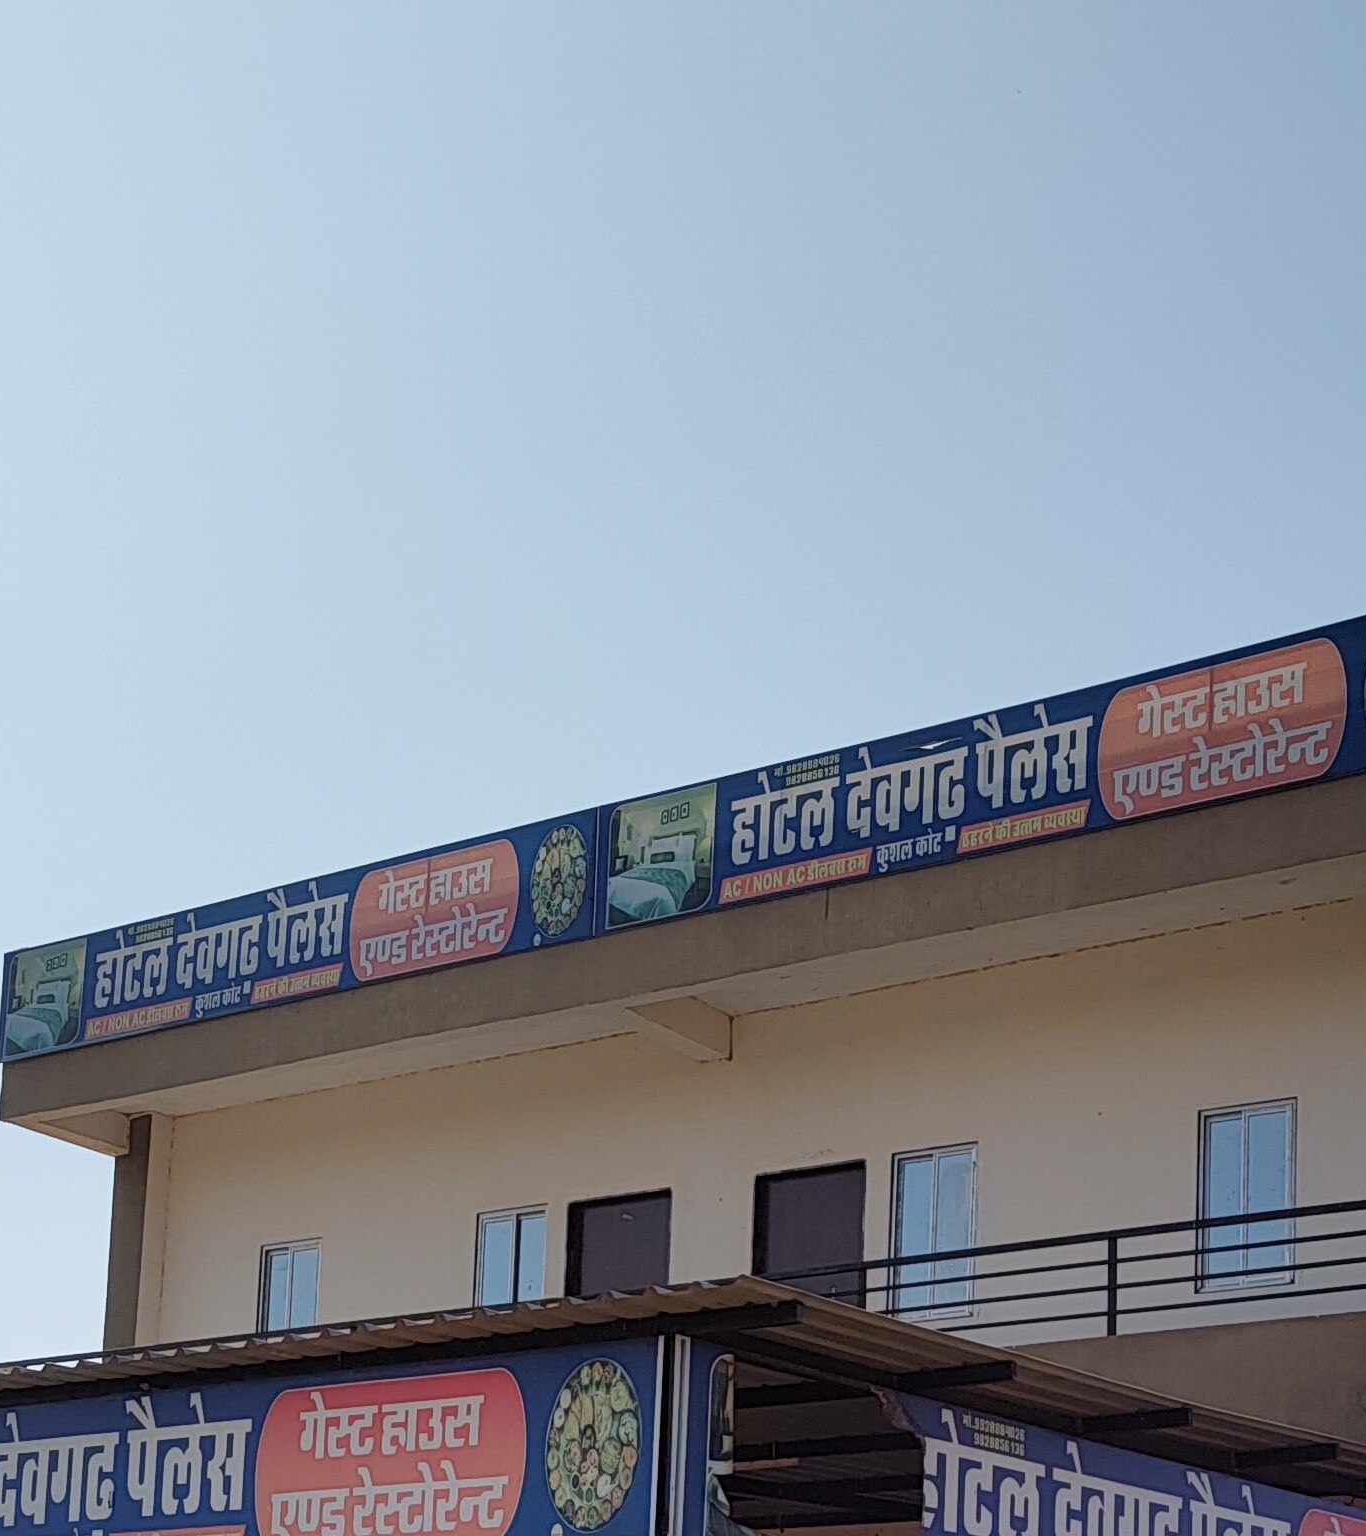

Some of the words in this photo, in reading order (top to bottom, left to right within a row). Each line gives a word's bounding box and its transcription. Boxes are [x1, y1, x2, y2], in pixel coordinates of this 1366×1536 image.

[1137, 685, 1210, 737] गेस्ट
[1213, 661, 1307, 724] हाउस
[731, 771, 840, 865] होटल
[973, 703, 1093, 808] पैलेस
[1113, 755, 1188, 815] एण्ड
[1189, 718, 1332, 792] रेस्टोरेन्ट
[876, 838, 914, 873] कुशल
[915, 828, 943, 857] कोट
[995, 822, 1012, 844] की
[377, 870, 428, 914] गेस्ट
[429, 858, 493, 905] हाउस
[722, 880, 742, 899] AC
[753, 871, 783, 893] NON
[786, 868, 806, 887] AC
[94, 930, 173, 1008] होटल
[266, 880, 349, 968] पैलेस
[360, 929, 411, 977] एण्ड
[411, 903, 508, 960] रेस्टोरेन्ट
[86, 1019, 101, 1036] AC
[108, 1013, 130, 1032] NON
[132, 1009, 146, 1026] AC
[195, 990, 221, 1018] कुशल
[222, 982, 242, 1004] कोट
[125, 1392, 252, 1516] पैलेस
[300, 1391, 378, 1459] गेस्ट
[382, 1395, 484, 1455] हाउस
[353, 1460, 508, 1536] रेस्टोरेन्ट
